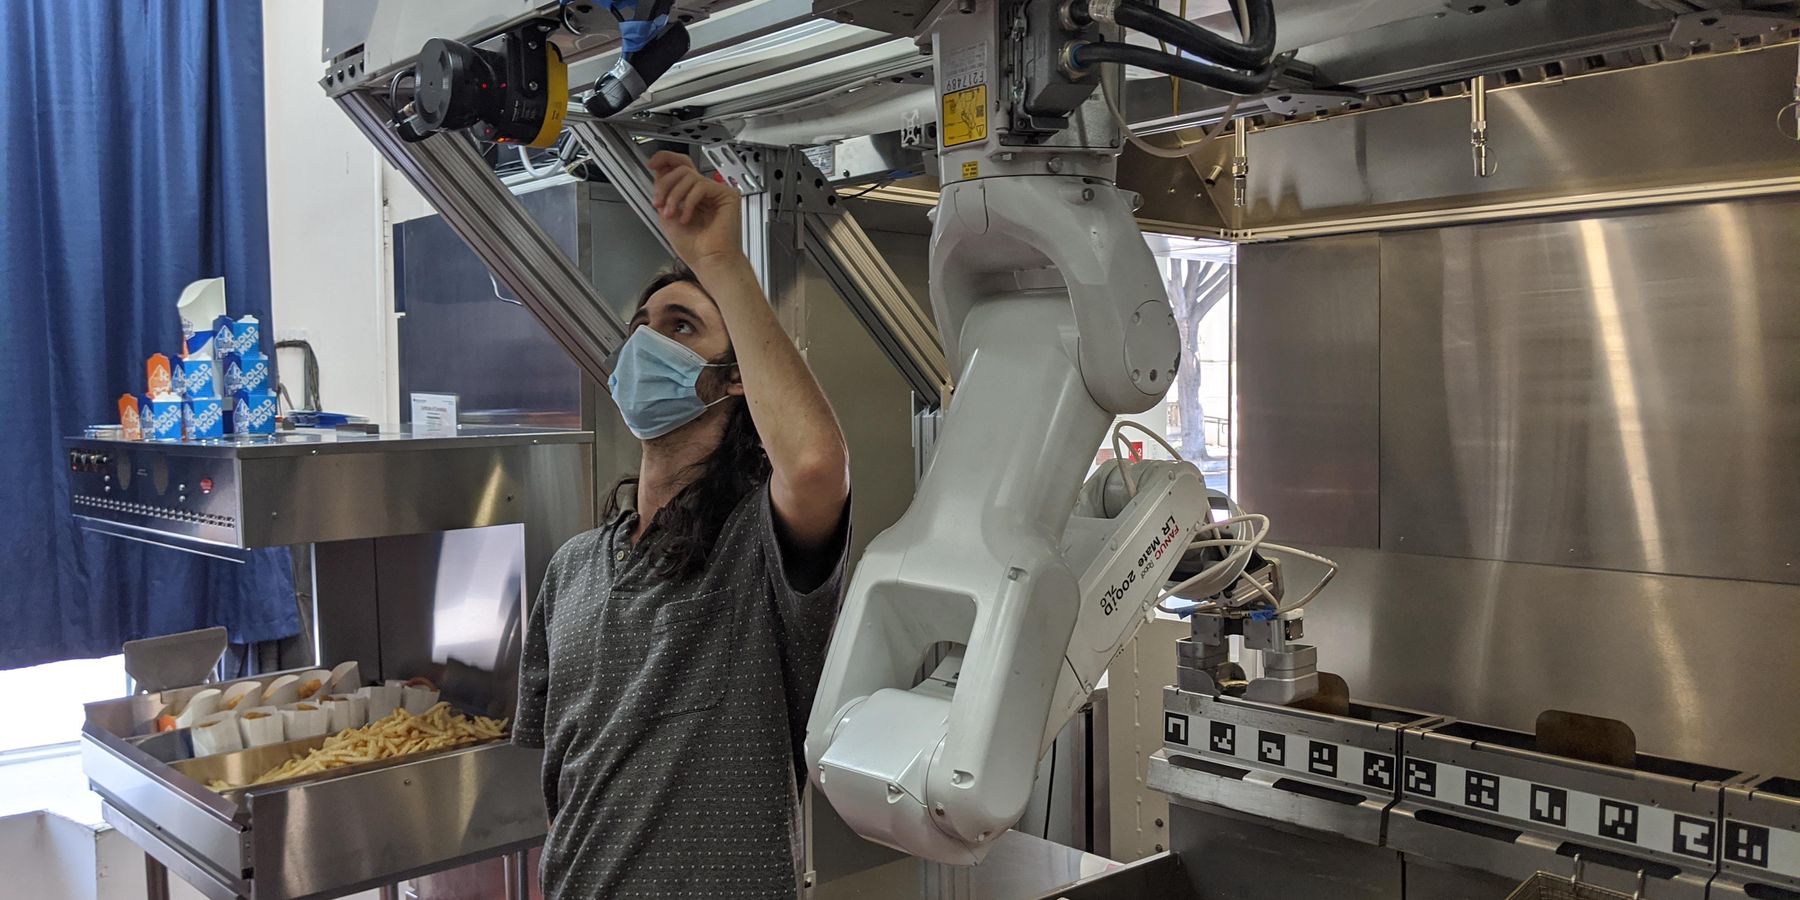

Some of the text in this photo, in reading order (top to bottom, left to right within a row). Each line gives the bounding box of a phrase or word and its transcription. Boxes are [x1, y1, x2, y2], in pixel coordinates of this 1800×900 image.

[232, 326, 255, 349] BOLD
[185, 363, 208, 388] BOLD
[241, 362, 264, 386] BOLD
[153, 405, 177, 428] BOLD
[193, 402, 218, 428] BOLD
[249, 399, 272, 422] BOLD
[1141, 524, 1180, 579] FANUC Robot
[1104, 515, 1176, 616] LR Mate 200iD
[1100, 585, 1117, 608] 7LC
